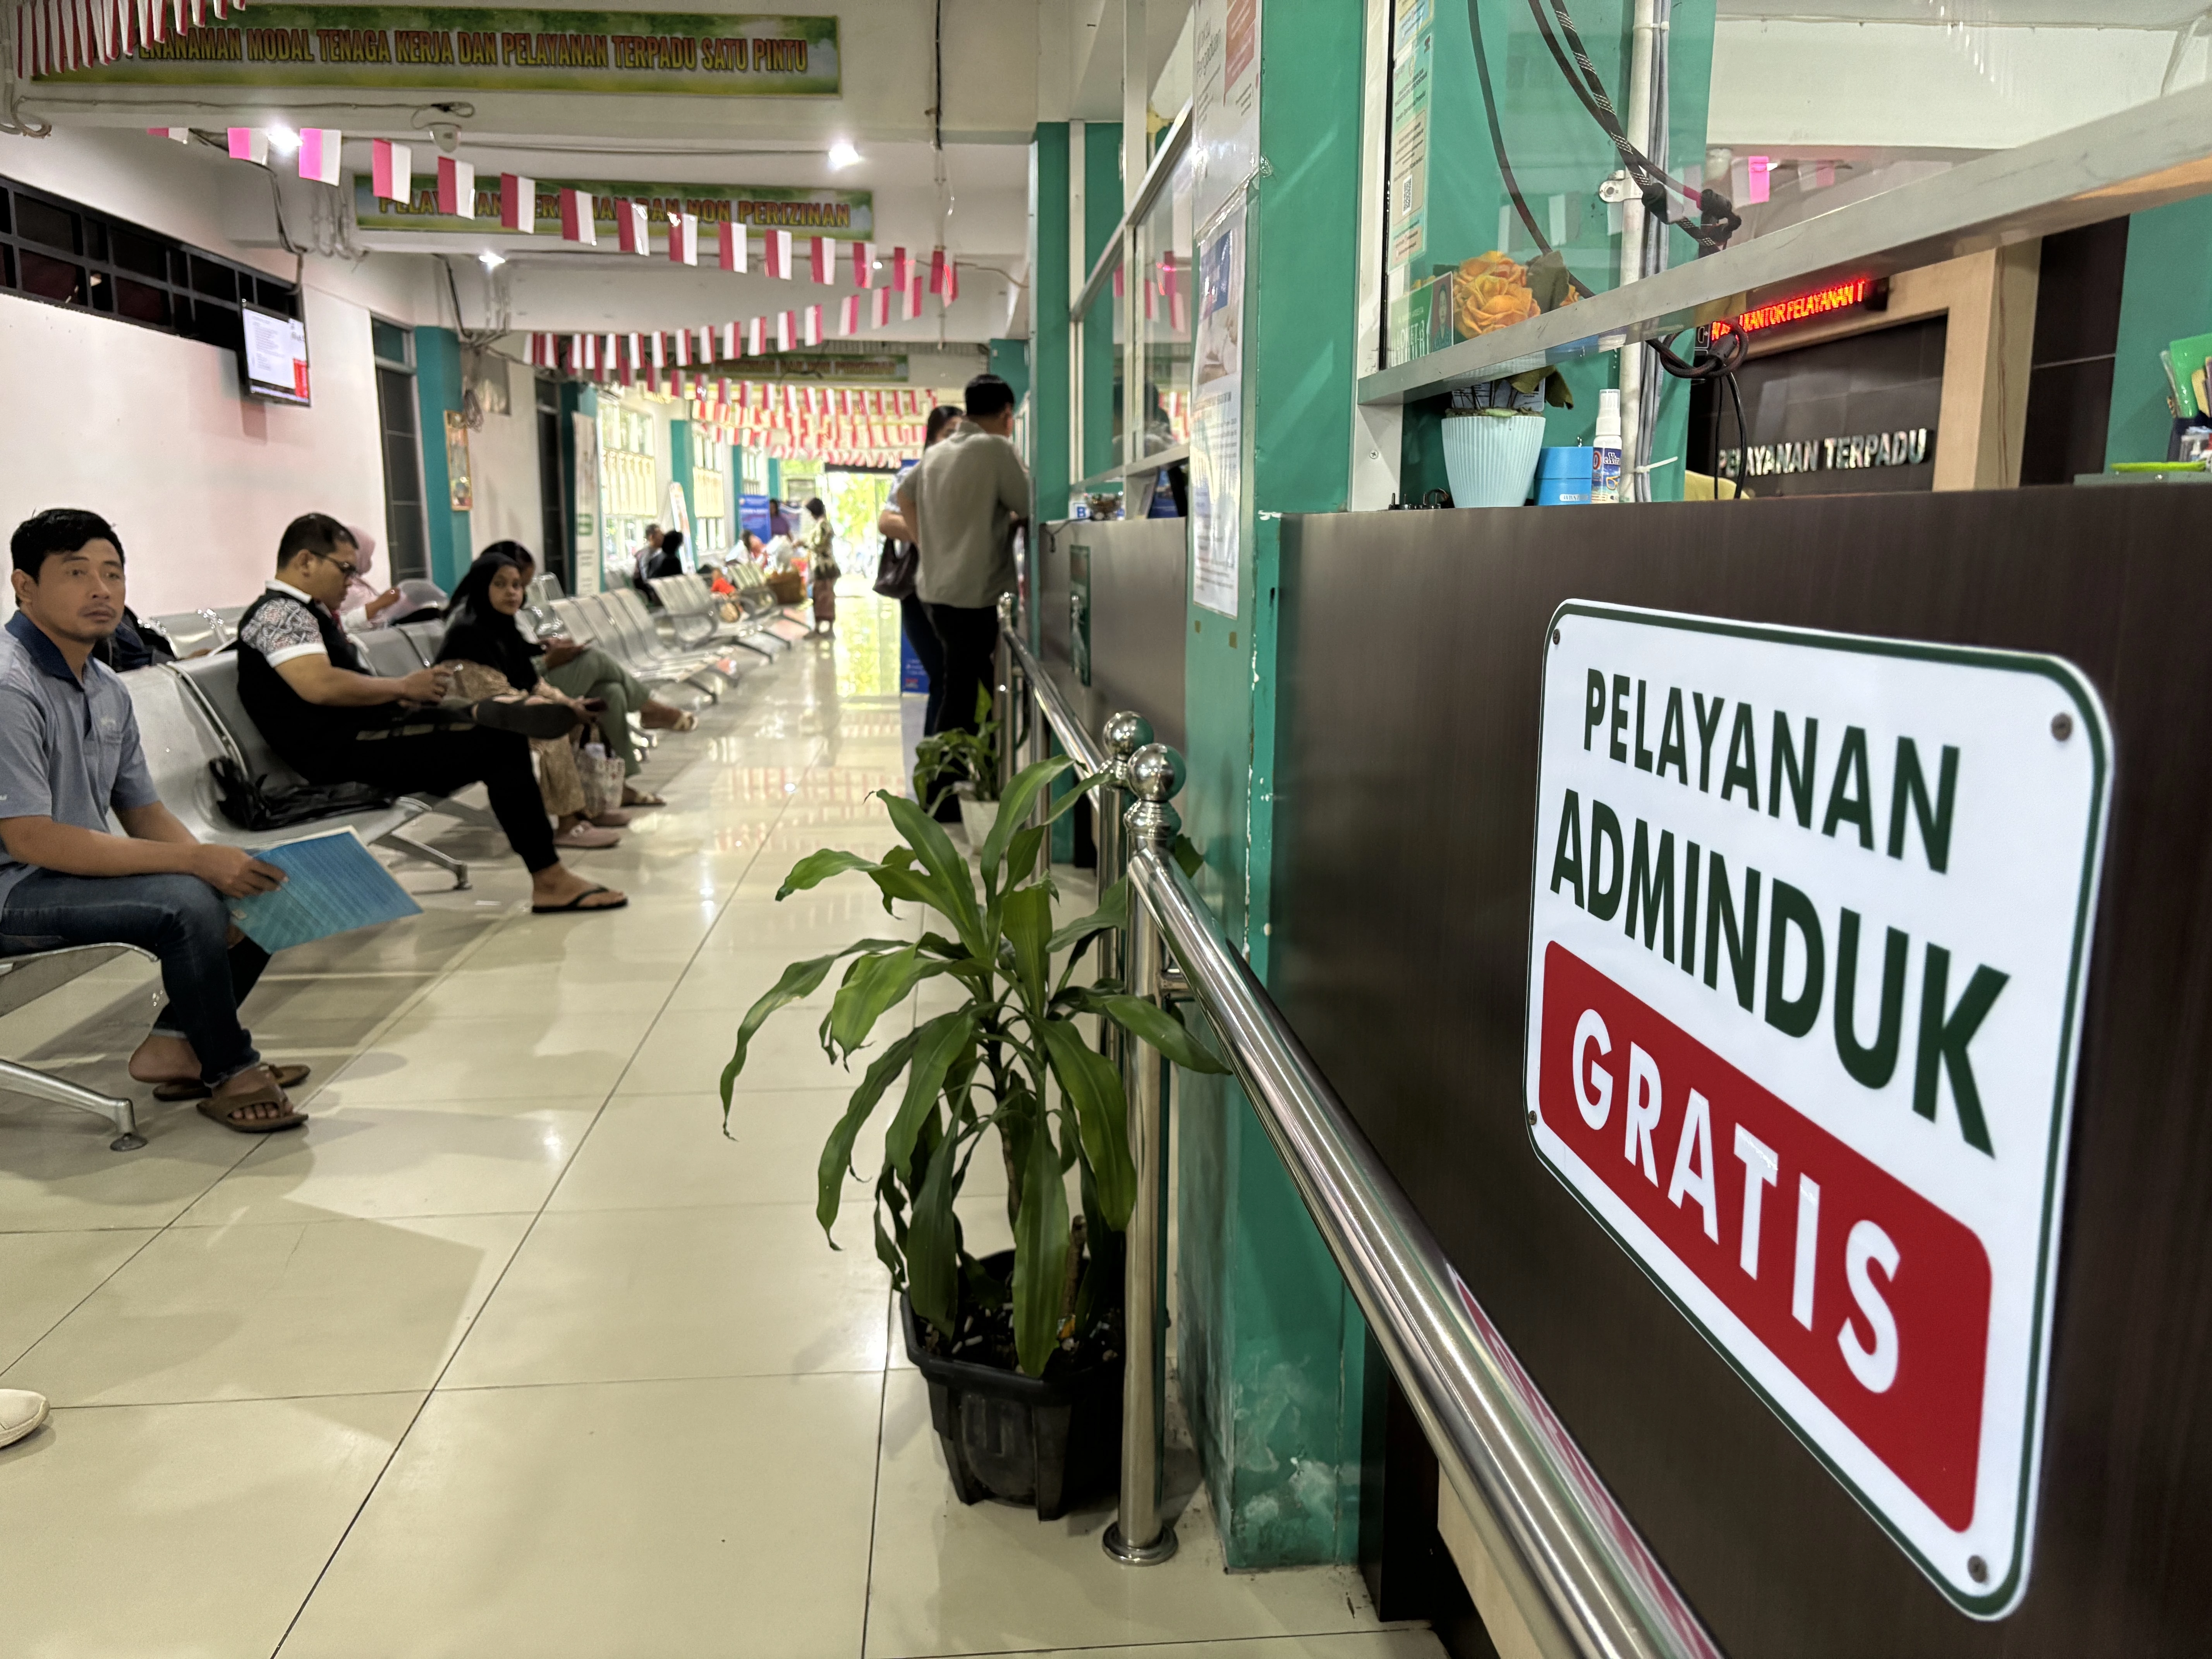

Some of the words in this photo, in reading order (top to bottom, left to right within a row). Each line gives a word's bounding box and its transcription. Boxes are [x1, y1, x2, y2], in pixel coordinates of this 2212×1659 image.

[246, 28, 314, 62] MODAL
[316, 29, 391, 63] TENAGA
[394, 30, 454, 65] KERJA
[457, 31, 498, 65] DAN
[501, 33, 610, 67] PELAYANAN
[611, 35, 696, 69] TERPADU
[701, 37, 748, 71] SATU
[752, 38, 807, 72] PINTU
[737, 200, 849, 227] PERIZINAN
[1786, 282, 1854, 321] PELAYANAN
[1824, 428, 1927, 470] TERPADU
[1583, 667, 1960, 874] PELAYANAN
[1550, 788, 2010, 1161] ADMINDUK
[1572, 1008, 1901, 1394] GRATIS
